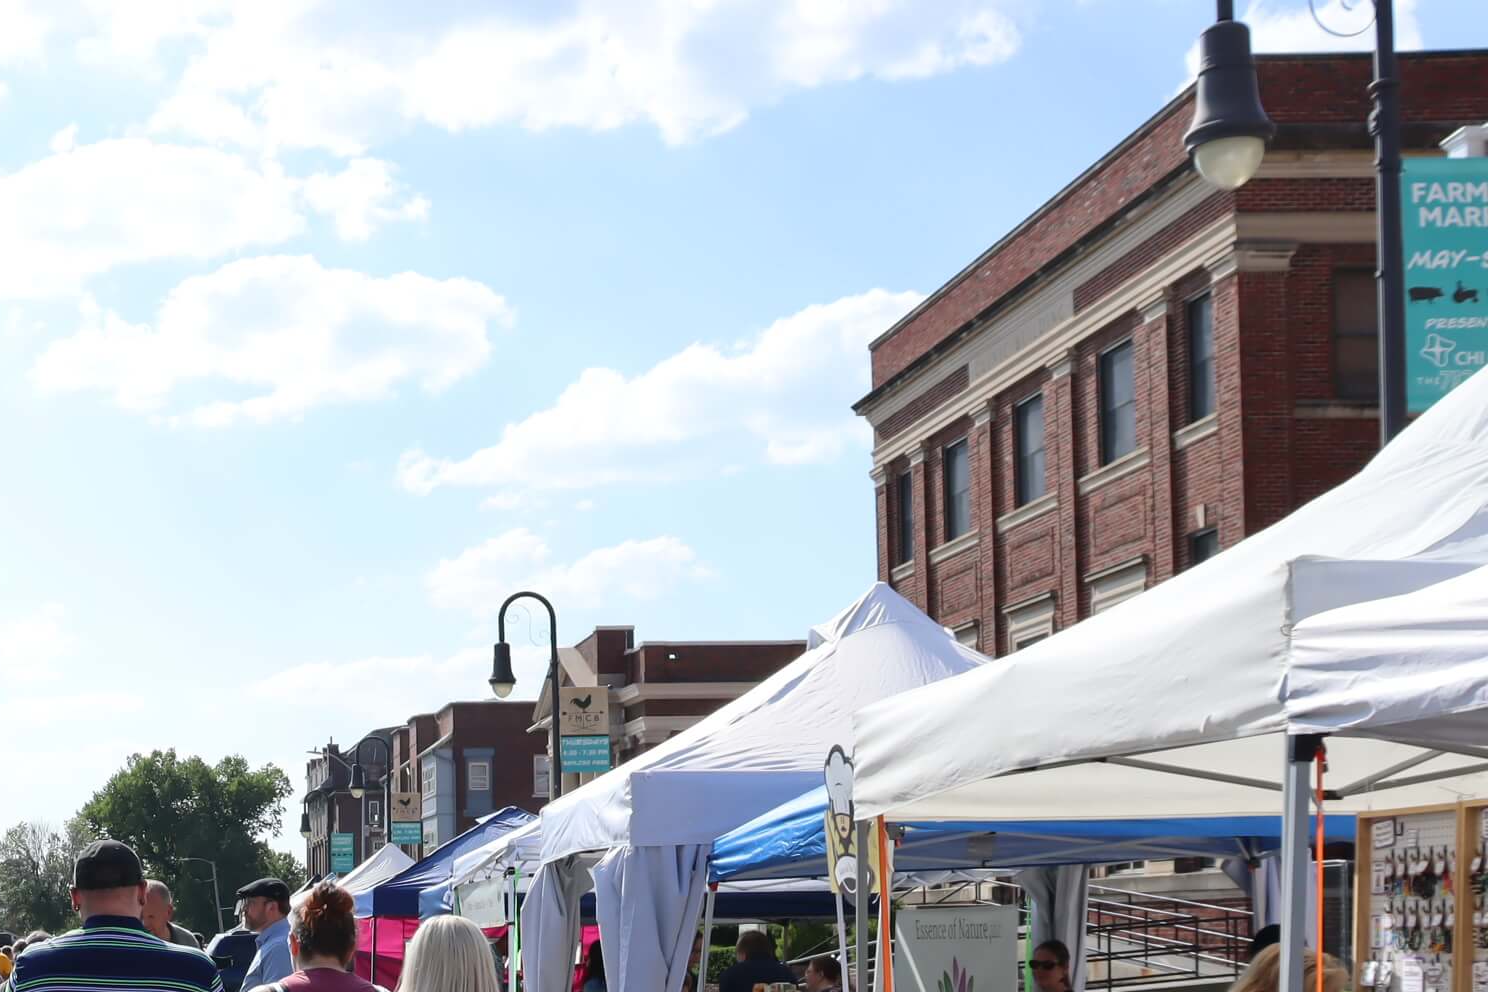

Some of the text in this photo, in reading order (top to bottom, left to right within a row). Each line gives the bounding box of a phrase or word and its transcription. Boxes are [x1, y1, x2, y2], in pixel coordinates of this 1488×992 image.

[1455, 351, 1485, 365] CHI
[915, 920, 946, 940] Essence
[948, 917, 957, 939] of
